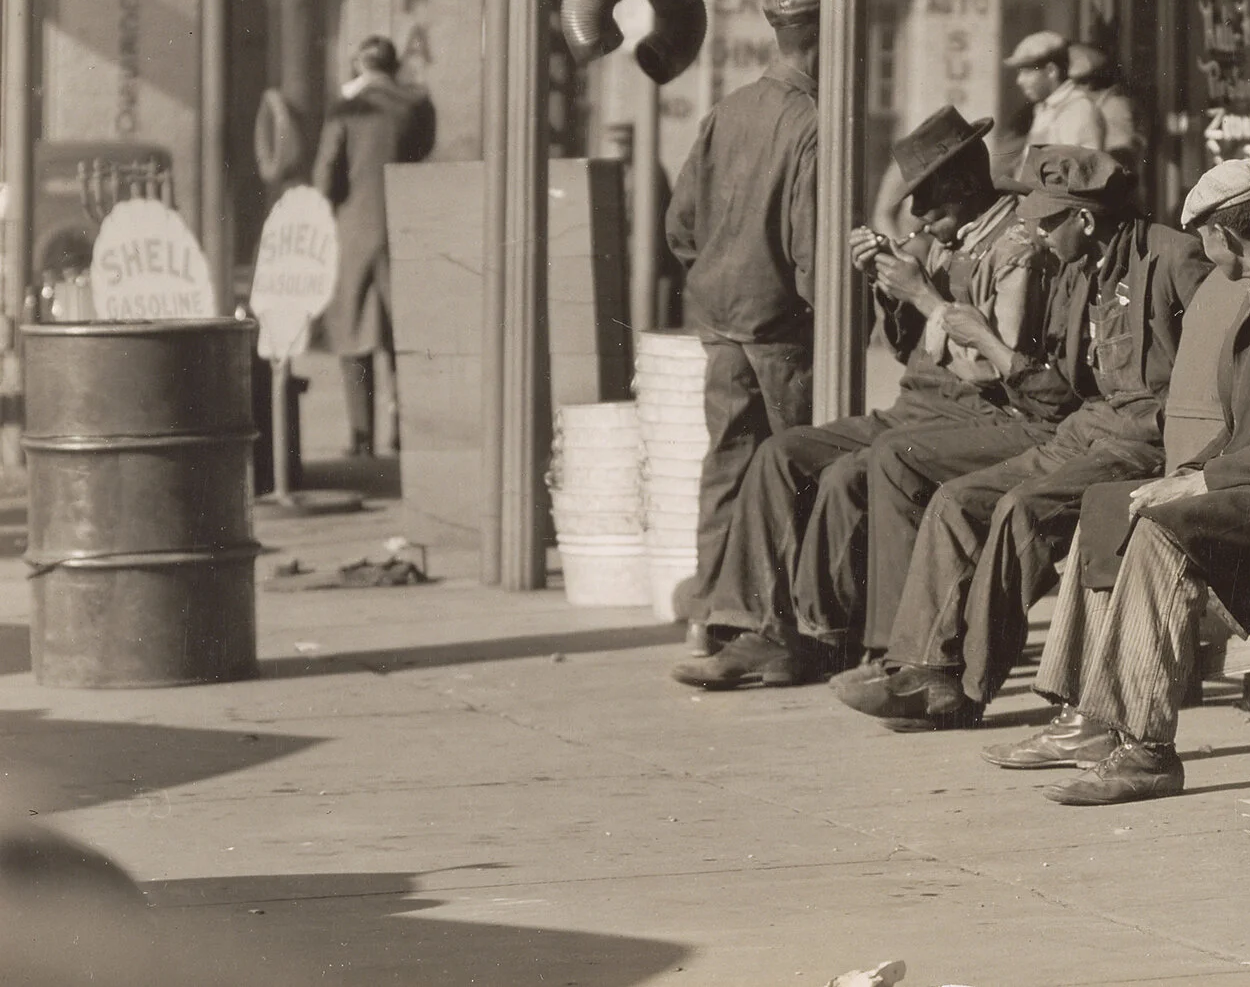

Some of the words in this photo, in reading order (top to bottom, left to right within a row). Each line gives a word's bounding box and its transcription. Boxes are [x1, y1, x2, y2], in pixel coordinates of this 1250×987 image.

[100, 237, 196, 286] SHELL
[262, 222, 331, 265] SHELL
[105, 289, 202, 318] GASOLINE
